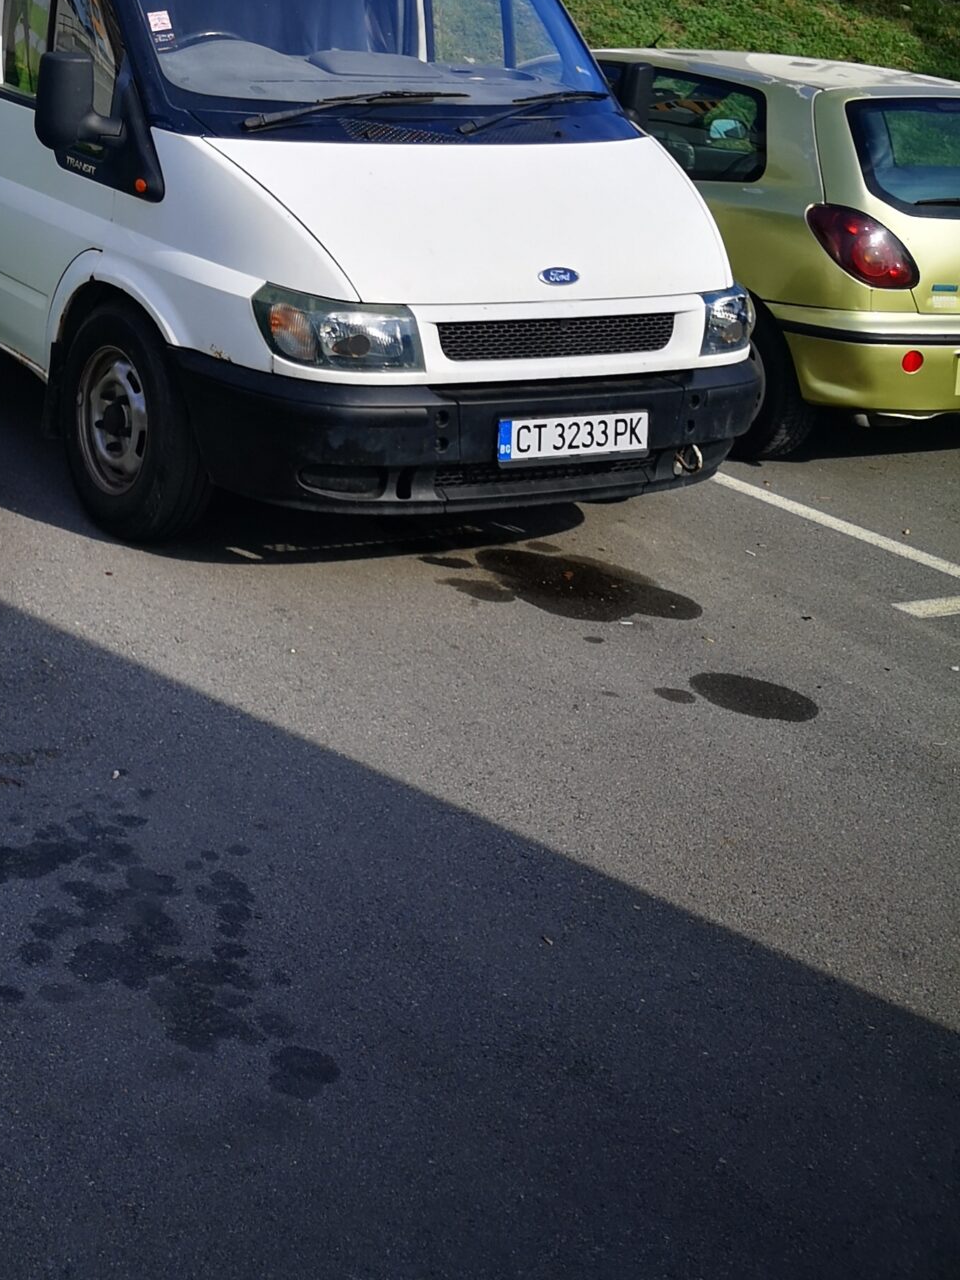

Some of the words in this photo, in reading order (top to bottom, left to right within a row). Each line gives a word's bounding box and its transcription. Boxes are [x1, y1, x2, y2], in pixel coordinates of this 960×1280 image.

[549, 270, 571, 282] Ford
[516, 424, 548, 453] CT
[552, 420, 609, 451] 3233
[613, 416, 643, 447] PK
[499, 444, 511, 454] BG
